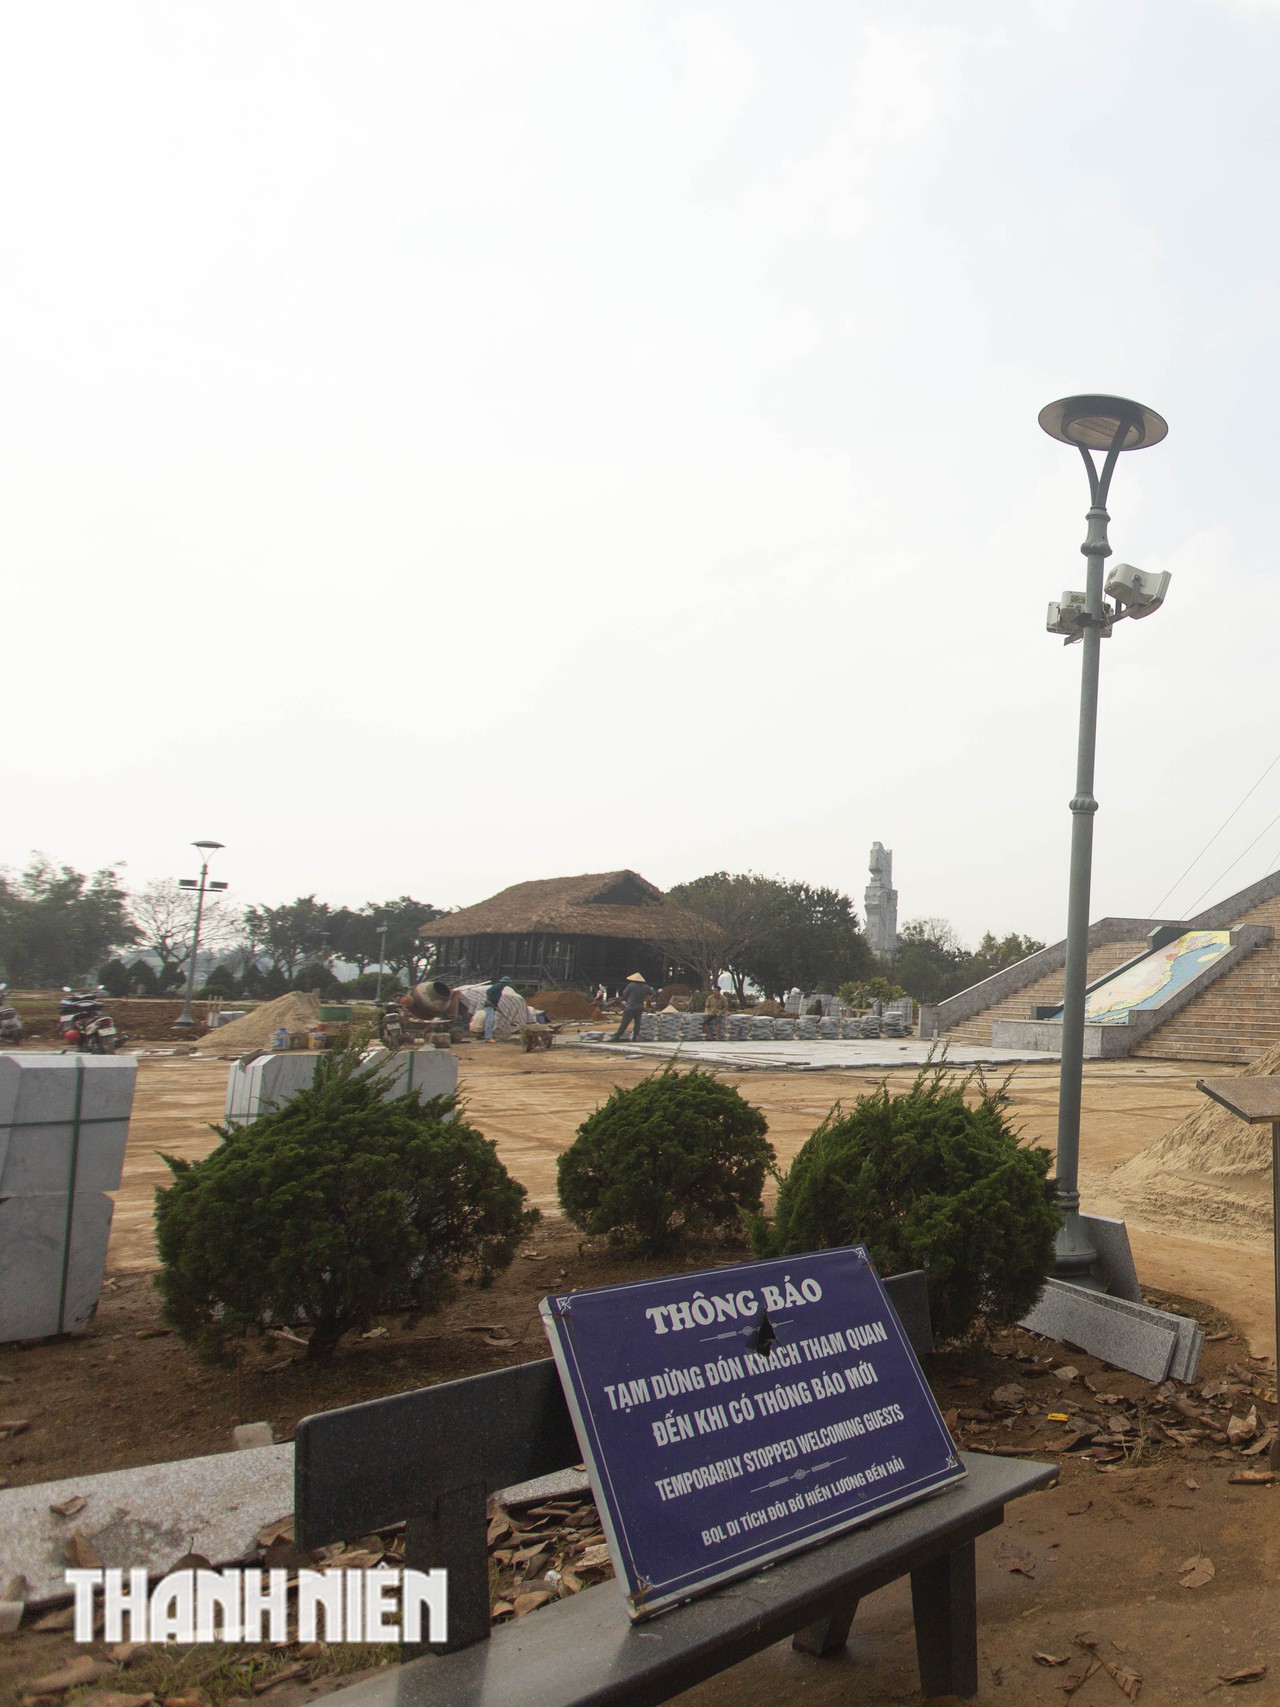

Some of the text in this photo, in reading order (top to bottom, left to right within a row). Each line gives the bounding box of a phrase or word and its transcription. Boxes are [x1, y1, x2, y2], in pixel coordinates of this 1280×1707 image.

[645, 1275, 823, 1335] THÔNG BÁO
[603, 1377, 652, 1414] TẠM
[650, 1366, 706, 1400] DỪNG
[704, 1355, 745, 1386] ĐÓN
[799, 1331, 848, 1361] THAM
[845, 1321, 889, 1351] QUAN
[651, 1360, 879, 1447] ĐẾN KHI CÓ THÔNG BÁO MỚI
[654, 1403, 905, 1502] TEMPORARILY STOPPED WELCOMING GUESTS
[701, 1455, 905, 1546] BQL DI TÍCH ĐÔI BỜ HIỀN LƯƠNG BẾN HẢI
